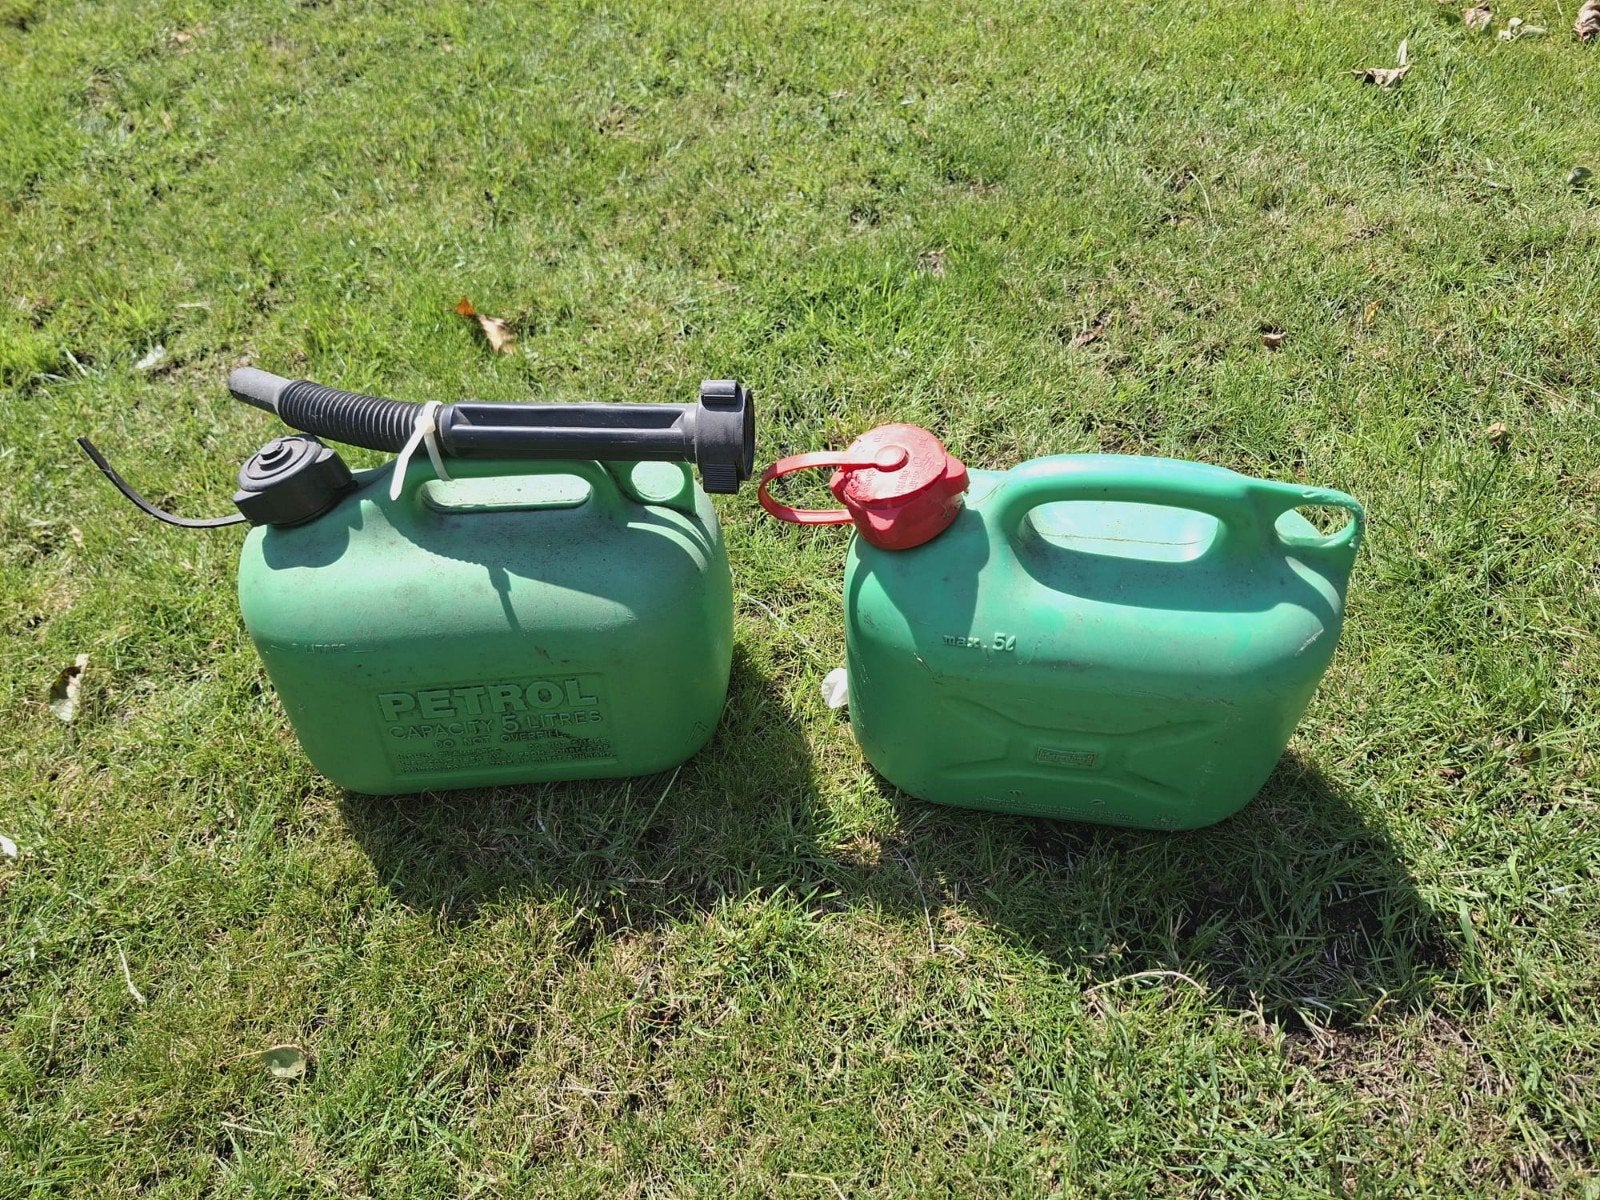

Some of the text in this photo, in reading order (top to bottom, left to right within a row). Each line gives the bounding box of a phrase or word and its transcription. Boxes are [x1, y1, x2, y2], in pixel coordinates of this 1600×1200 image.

[378, 678, 598, 721] PETROL
[389, 710, 603, 740] CAPACITY 5 LITRES
[434, 729, 564, 749] DO NOT OVERFILL
